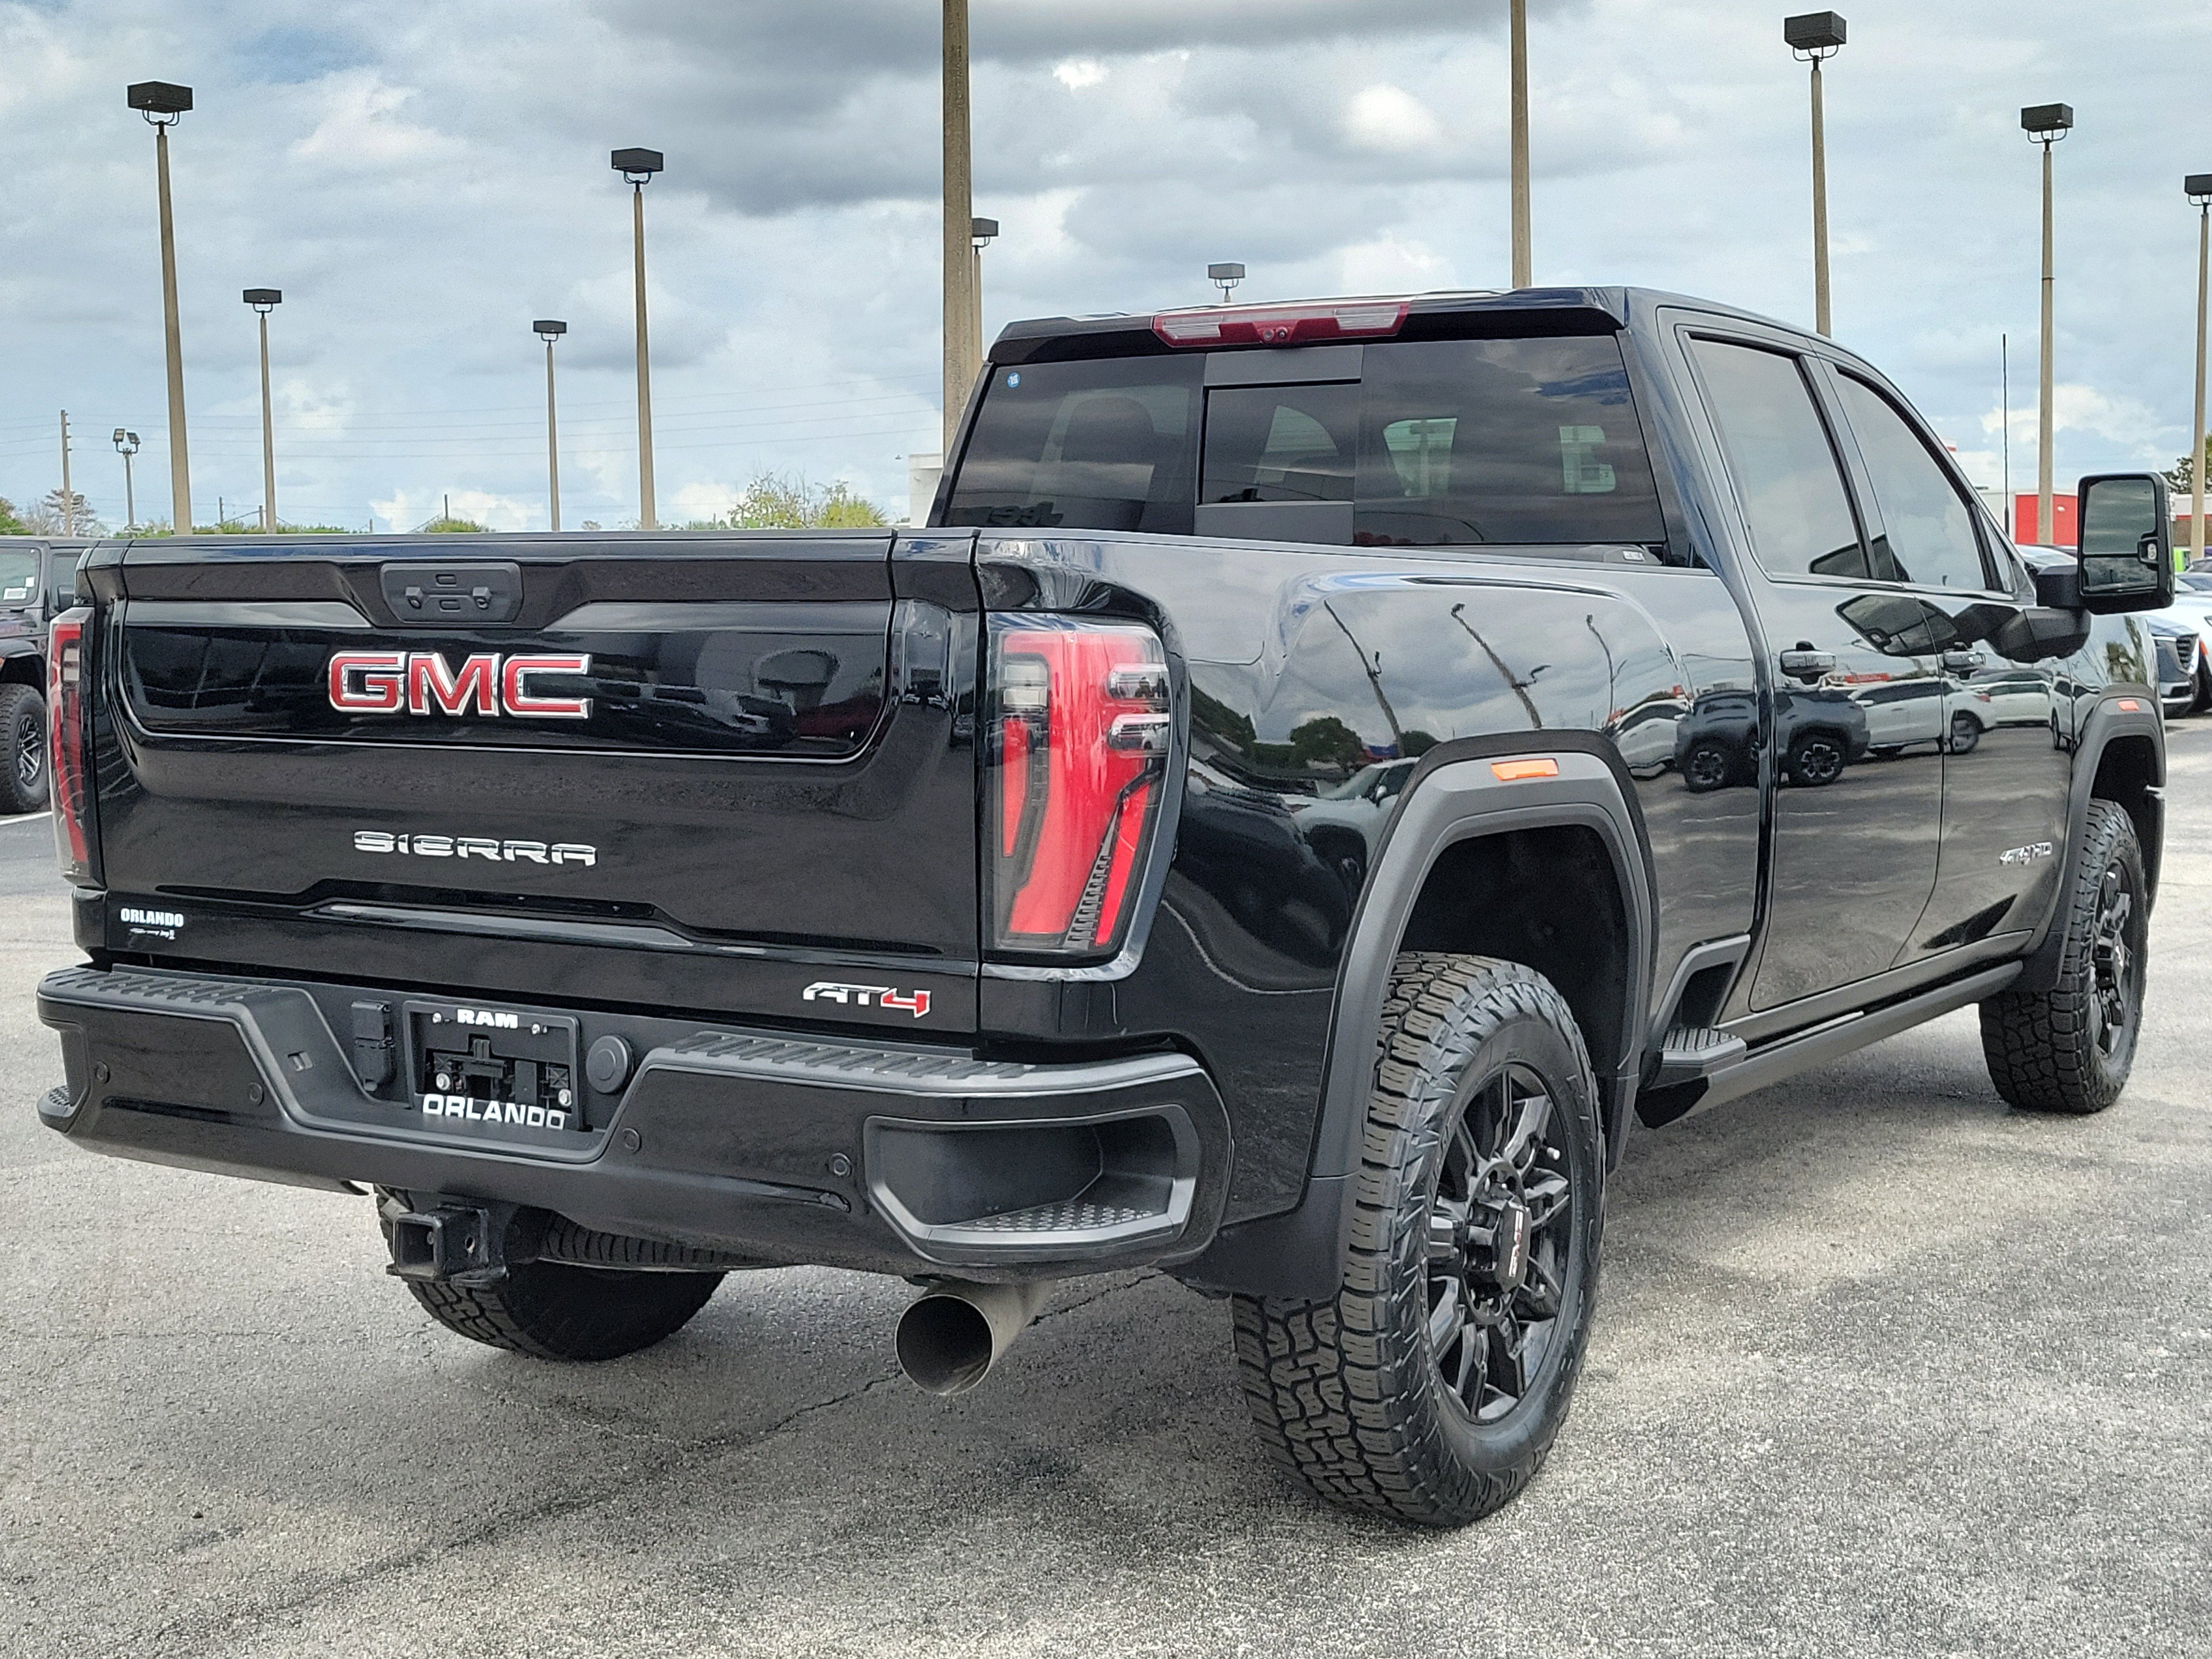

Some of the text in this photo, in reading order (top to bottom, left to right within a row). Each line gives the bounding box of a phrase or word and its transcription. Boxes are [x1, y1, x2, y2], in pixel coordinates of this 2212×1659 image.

[329, 651, 592, 719] GMC
[354, 831, 597, 866] SIERRA
[121, 908, 184, 927] ORLANDO
[803, 982, 931, 1018] AT4
[457, 1009, 518, 1029] RAM
[423, 1094, 566, 1130] ORLANDO
